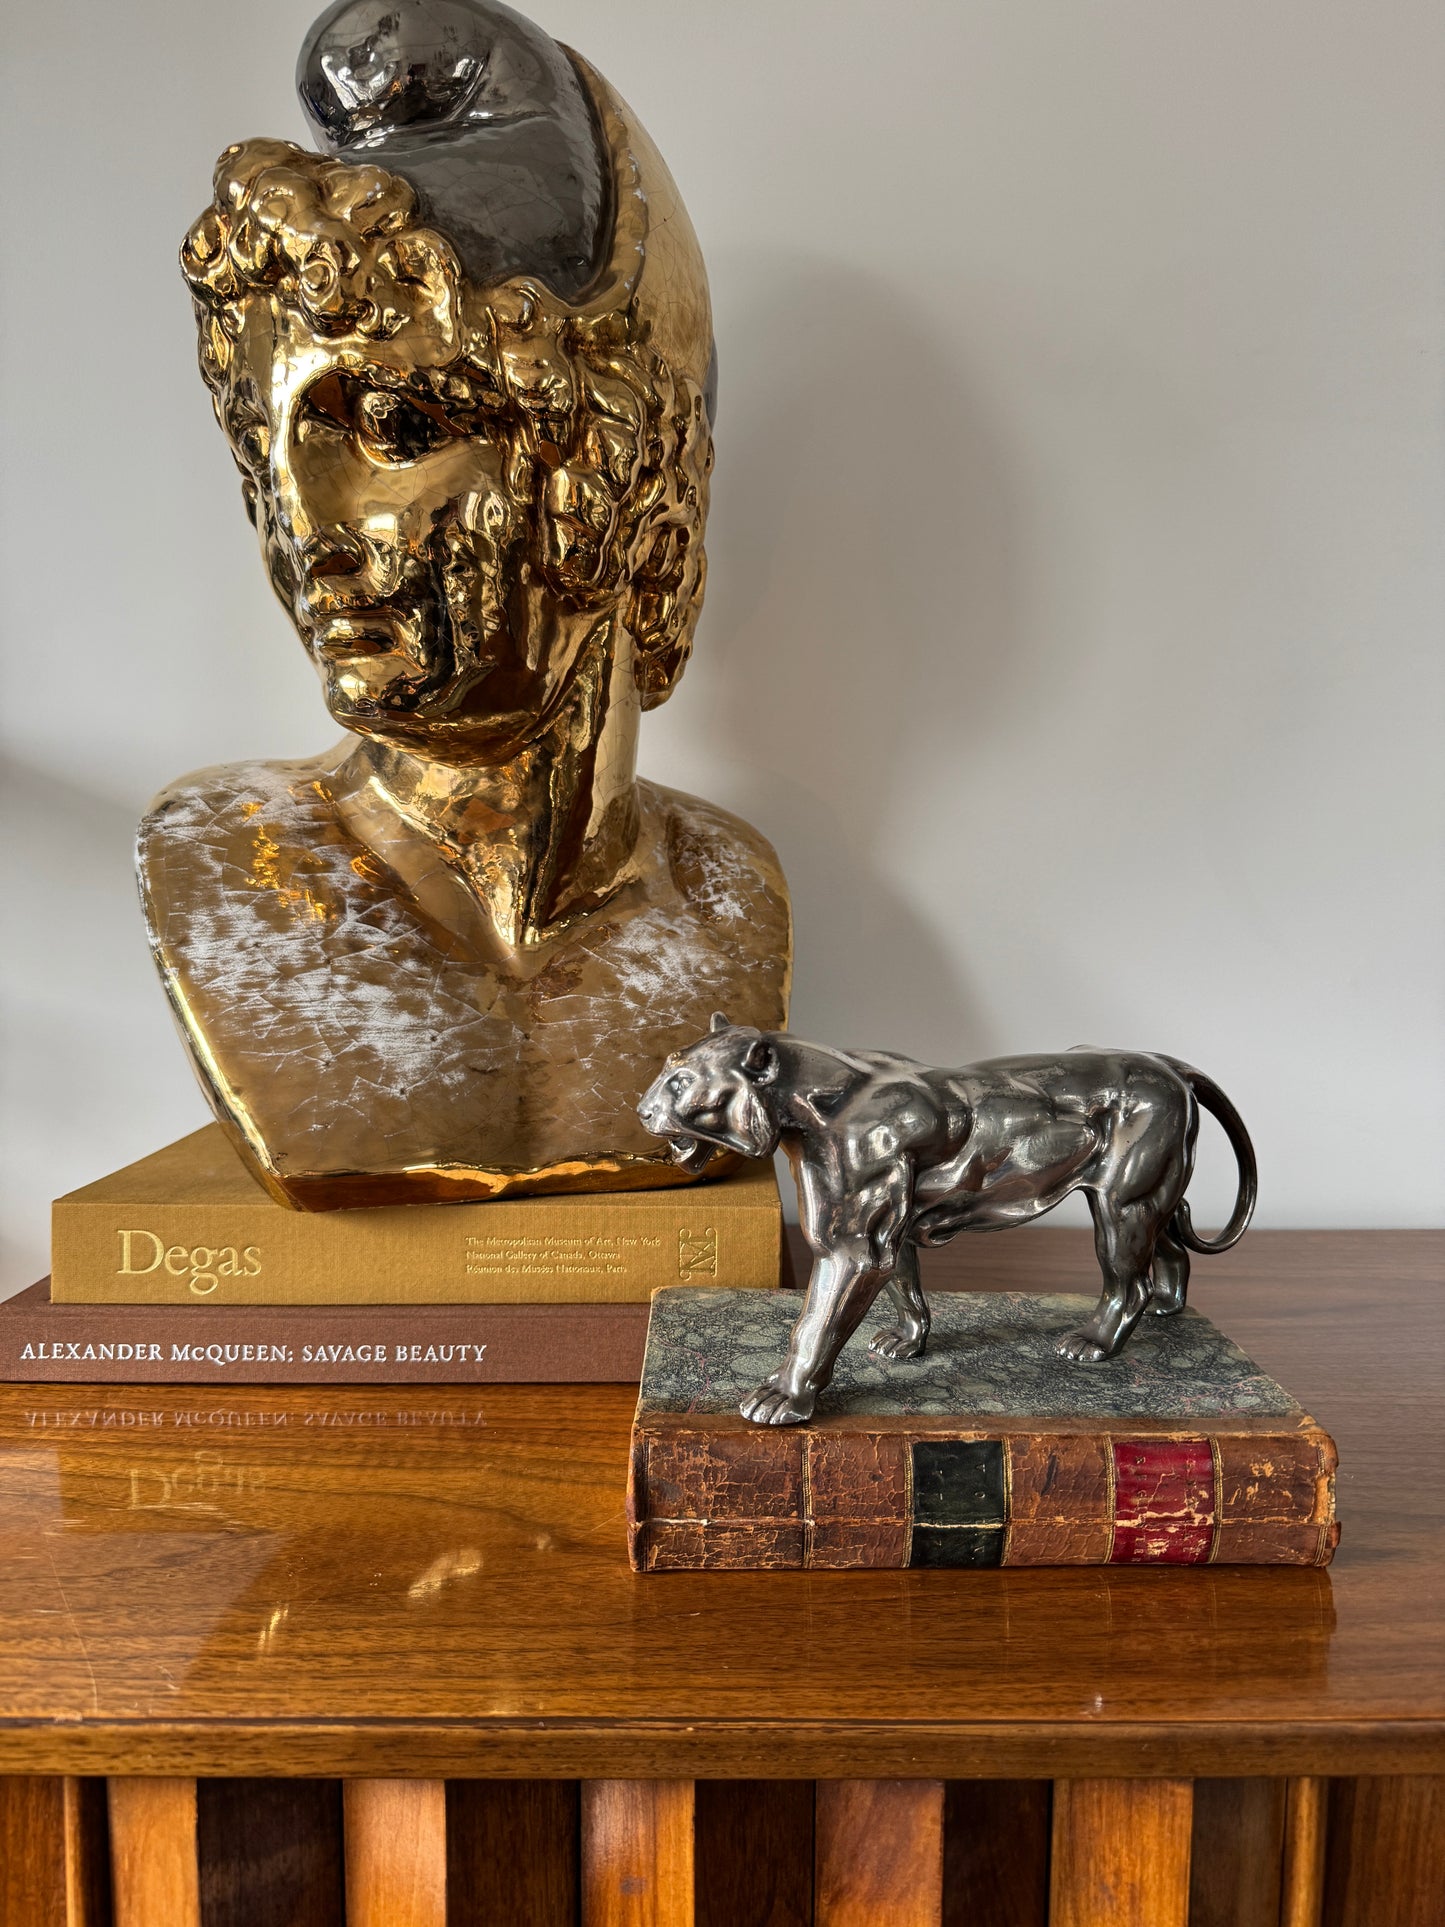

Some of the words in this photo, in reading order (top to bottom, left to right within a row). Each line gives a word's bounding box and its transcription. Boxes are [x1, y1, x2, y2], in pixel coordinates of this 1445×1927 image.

[465, 1236, 484, 1246] The
[486, 1236, 541, 1249] Metropolitan
[544, 1236, 582, 1246] Museum
[584, 1236, 595, 1246] of
[596, 1236, 614, 1247] Art,
[616, 1236, 637, 1246] New
[640, 1236, 661, 1246] York
[117, 1229, 262, 1295] Degas
[465, 1250, 503, 1260] National
[505, 1250, 537, 1262] Gallery
[539, 1250, 550, 1260] of
[550, 1250, 586, 1261] Canada,
[588, 1250, 621, 1260] Ottawa
[465, 1264, 503, 1274] Réunion
[505, 1264, 519, 1274] des
[521, 1264, 553, 1274] Musées
[555, 1264, 604, 1275] Nationaux,
[606, 1264, 628, 1274] Paris
[20, 1342, 164, 1361] ALEXANDER
[170, 1344, 294, 1366] McQUEEN:
[302, 1344, 387, 1363] SAVAGE
[395, 1344, 487, 1363] BEAUTY
